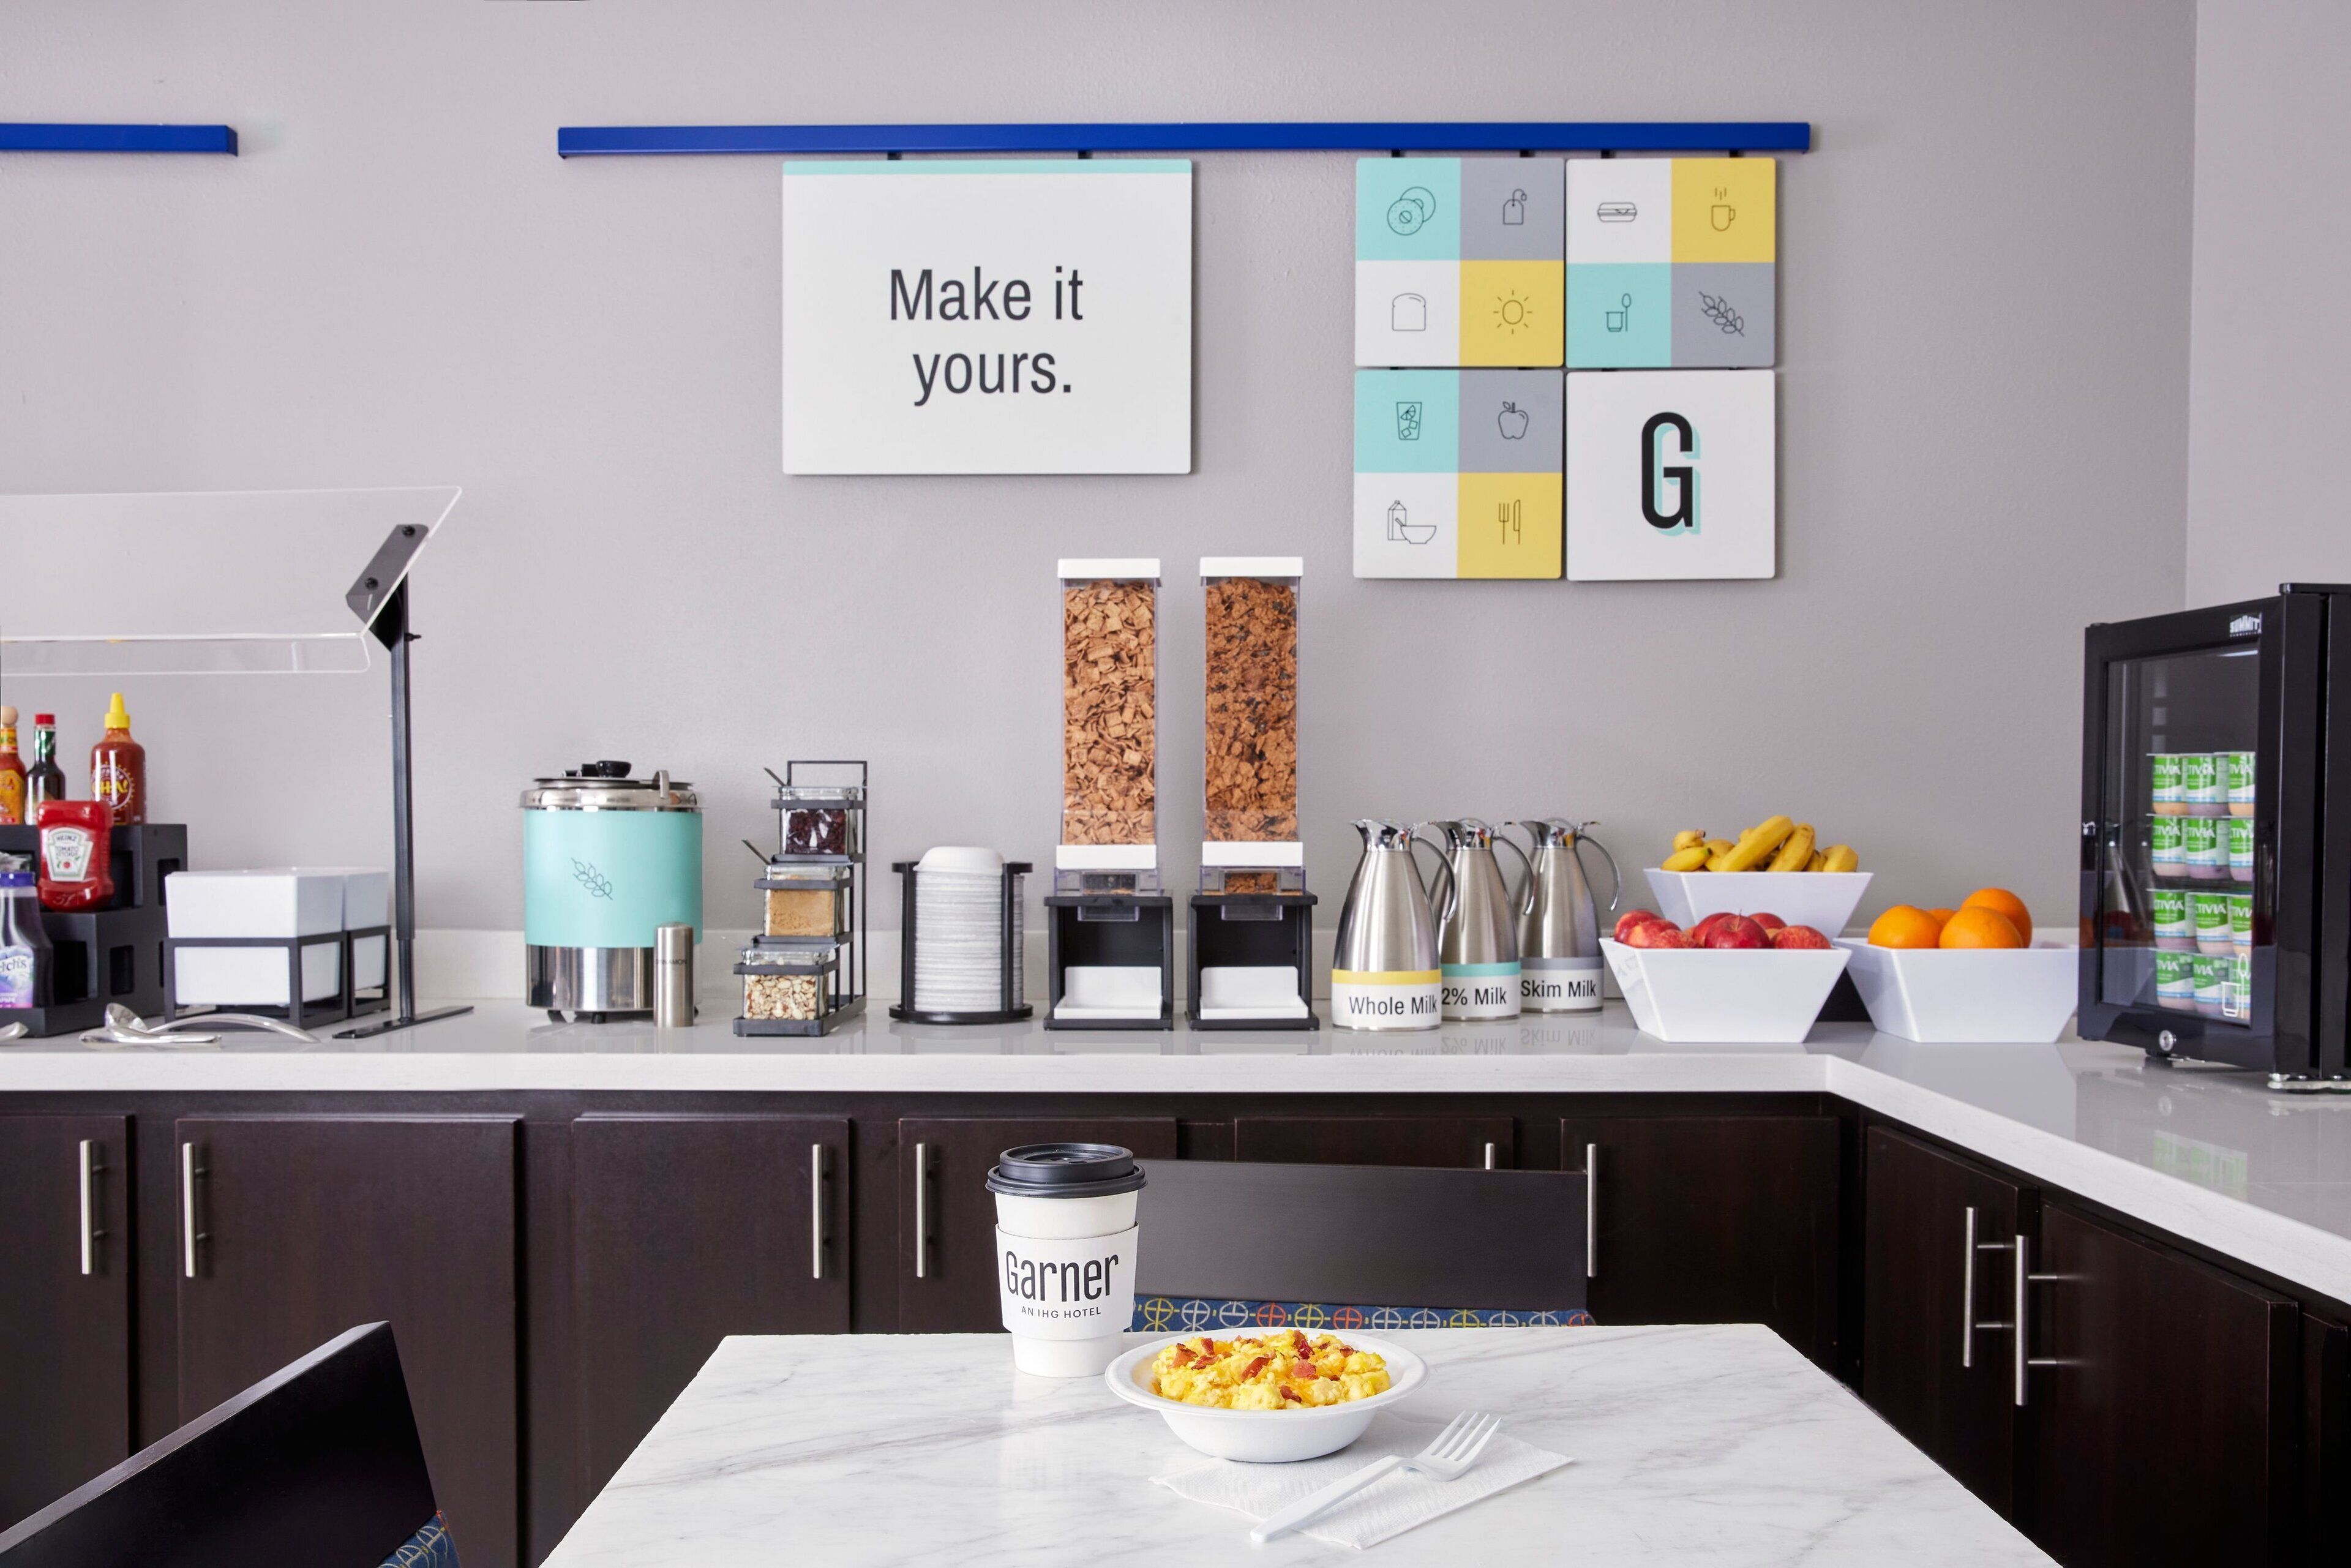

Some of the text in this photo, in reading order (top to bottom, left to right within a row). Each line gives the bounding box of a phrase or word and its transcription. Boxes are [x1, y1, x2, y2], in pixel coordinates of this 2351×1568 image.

[890, 266, 1084, 321] Make it
[912, 351, 1071, 407] yours.
[1641, 412, 1697, 531] G
[1349, 994, 1438, 1015] Whole Milk
[1441, 987, 1507, 1006] 2% Milk
[1521, 980, 1597, 998] Skim Milk
[1006, 1250, 1119, 1302] Garner
[1021, 1305, 1102, 1319] AN IHG HOTEL
